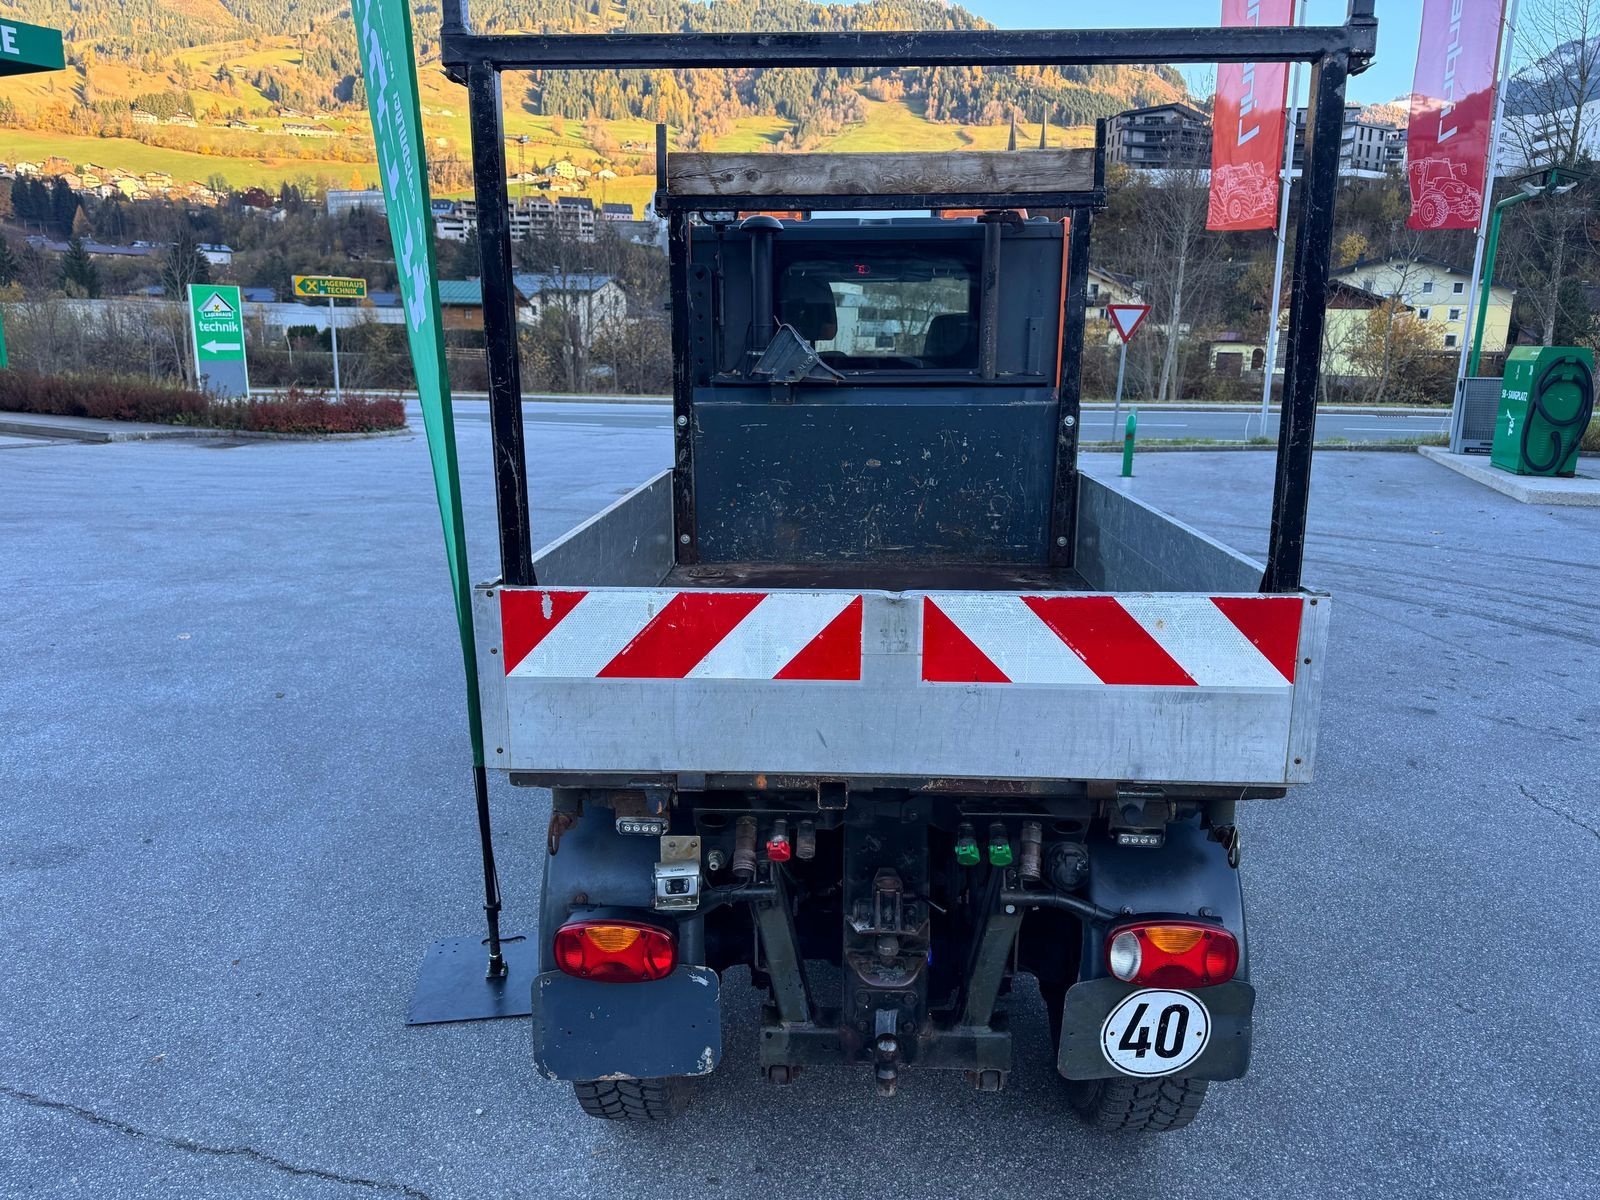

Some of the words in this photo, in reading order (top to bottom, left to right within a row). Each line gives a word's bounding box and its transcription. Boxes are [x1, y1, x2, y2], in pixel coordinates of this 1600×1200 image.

[0, 24, 20, 55] E
[319, 279, 364, 289] LAGERHAUS
[326, 286, 358, 295] TECHNIK
[198, 320, 239, 332] technik
[1118, 1003, 1190, 1059] 40
